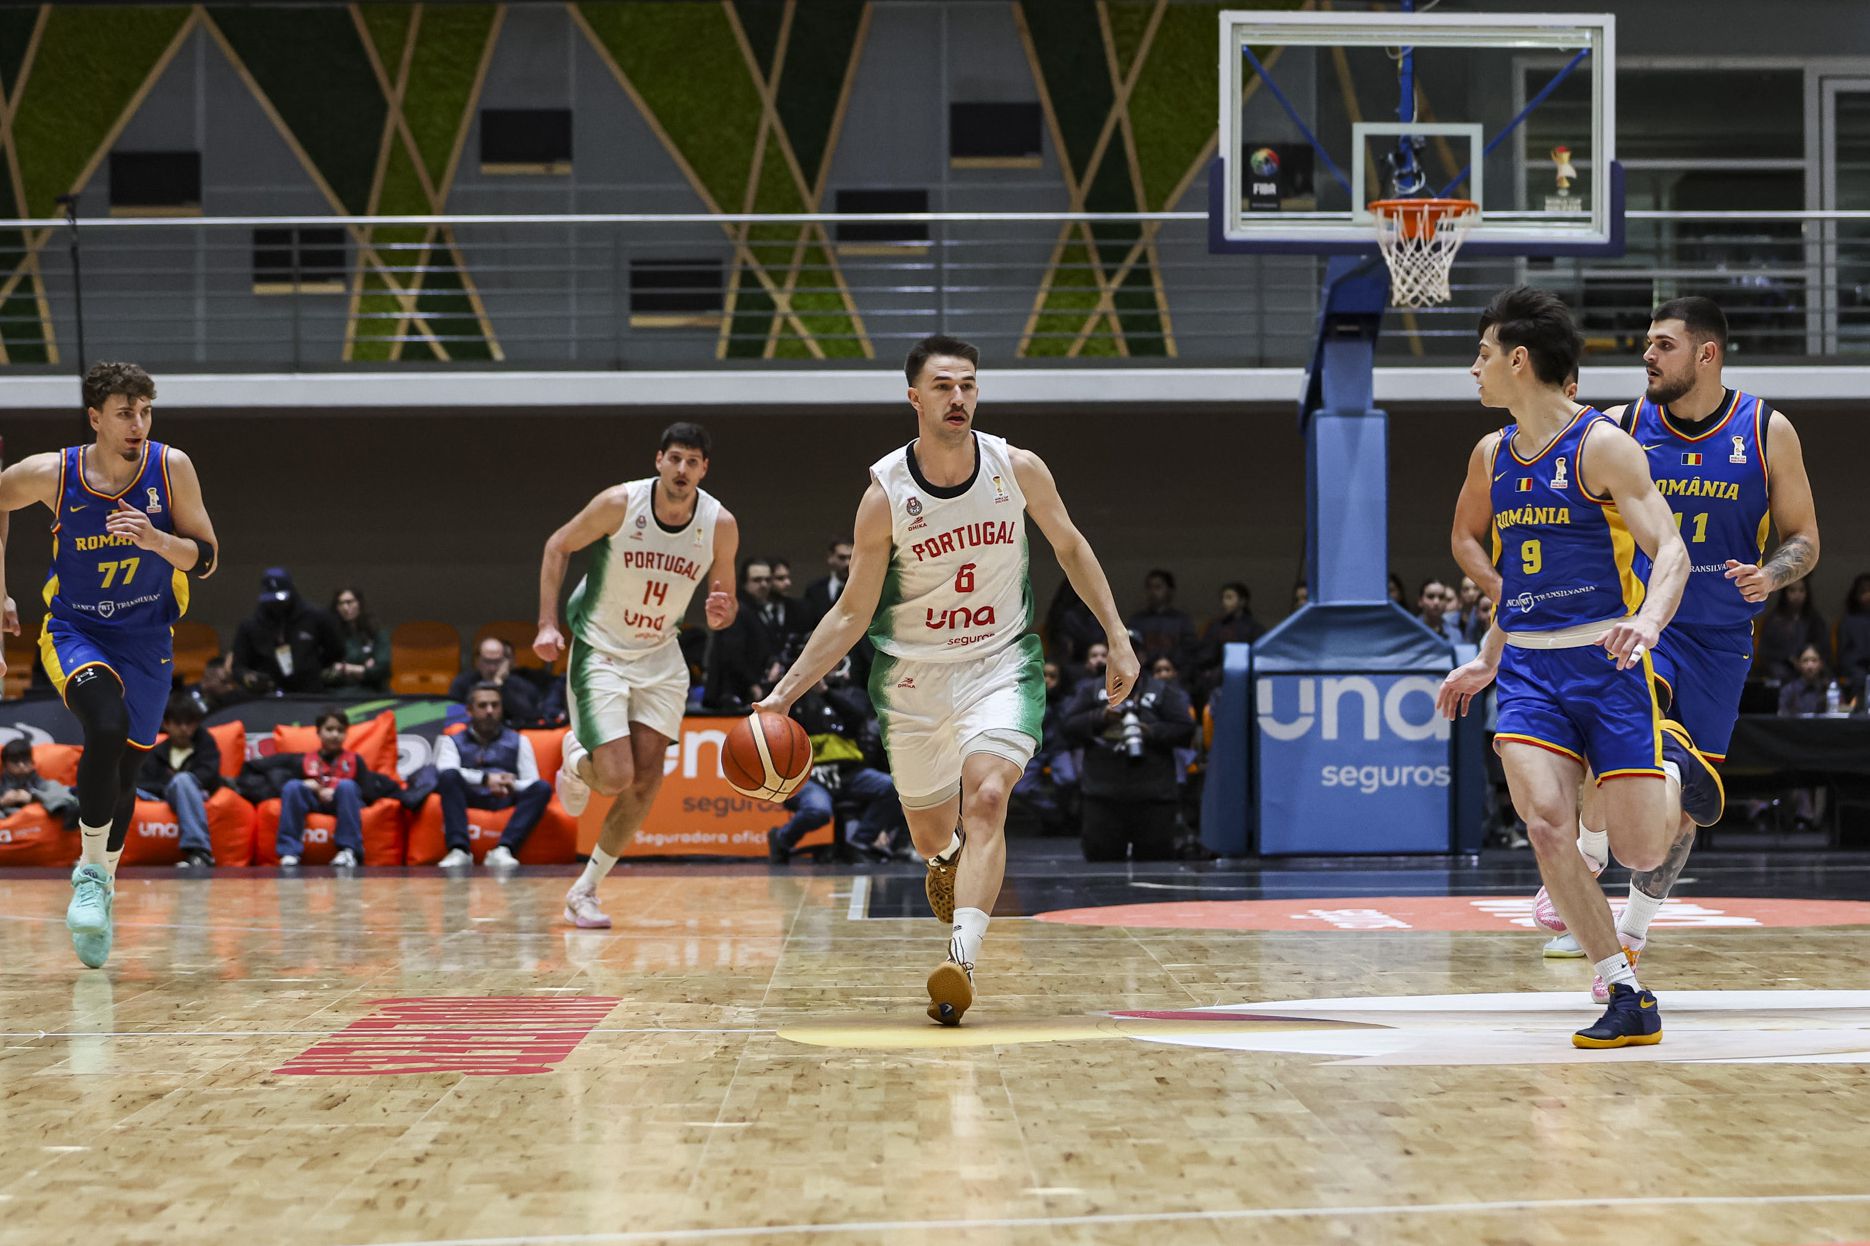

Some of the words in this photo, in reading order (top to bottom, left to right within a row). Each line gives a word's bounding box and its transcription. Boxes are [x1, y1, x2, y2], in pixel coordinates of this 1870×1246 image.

[1655, 476, 1740, 501] OMÂNIA
[1495, 504, 1571, 530] ROMÂNIA
[912, 521, 1016, 562] PORTUGAL
[624, 551, 701, 581] PORTUGAL
[1521, 539, 1542, 575] 9
[98, 557, 140, 589] 77
[954, 562, 977, 593] 6
[642, 580, 669, 606] 14
[624, 609, 666, 631] una
[926, 605, 996, 629] una
[1257, 676, 1451, 741] una
[1321, 764, 1451, 794] seguros
[138, 821, 178, 837] una
[301, 828, 328, 843] na
[634, 831, 728, 847] Seguradora
[731, 830, 769, 845] ofici
